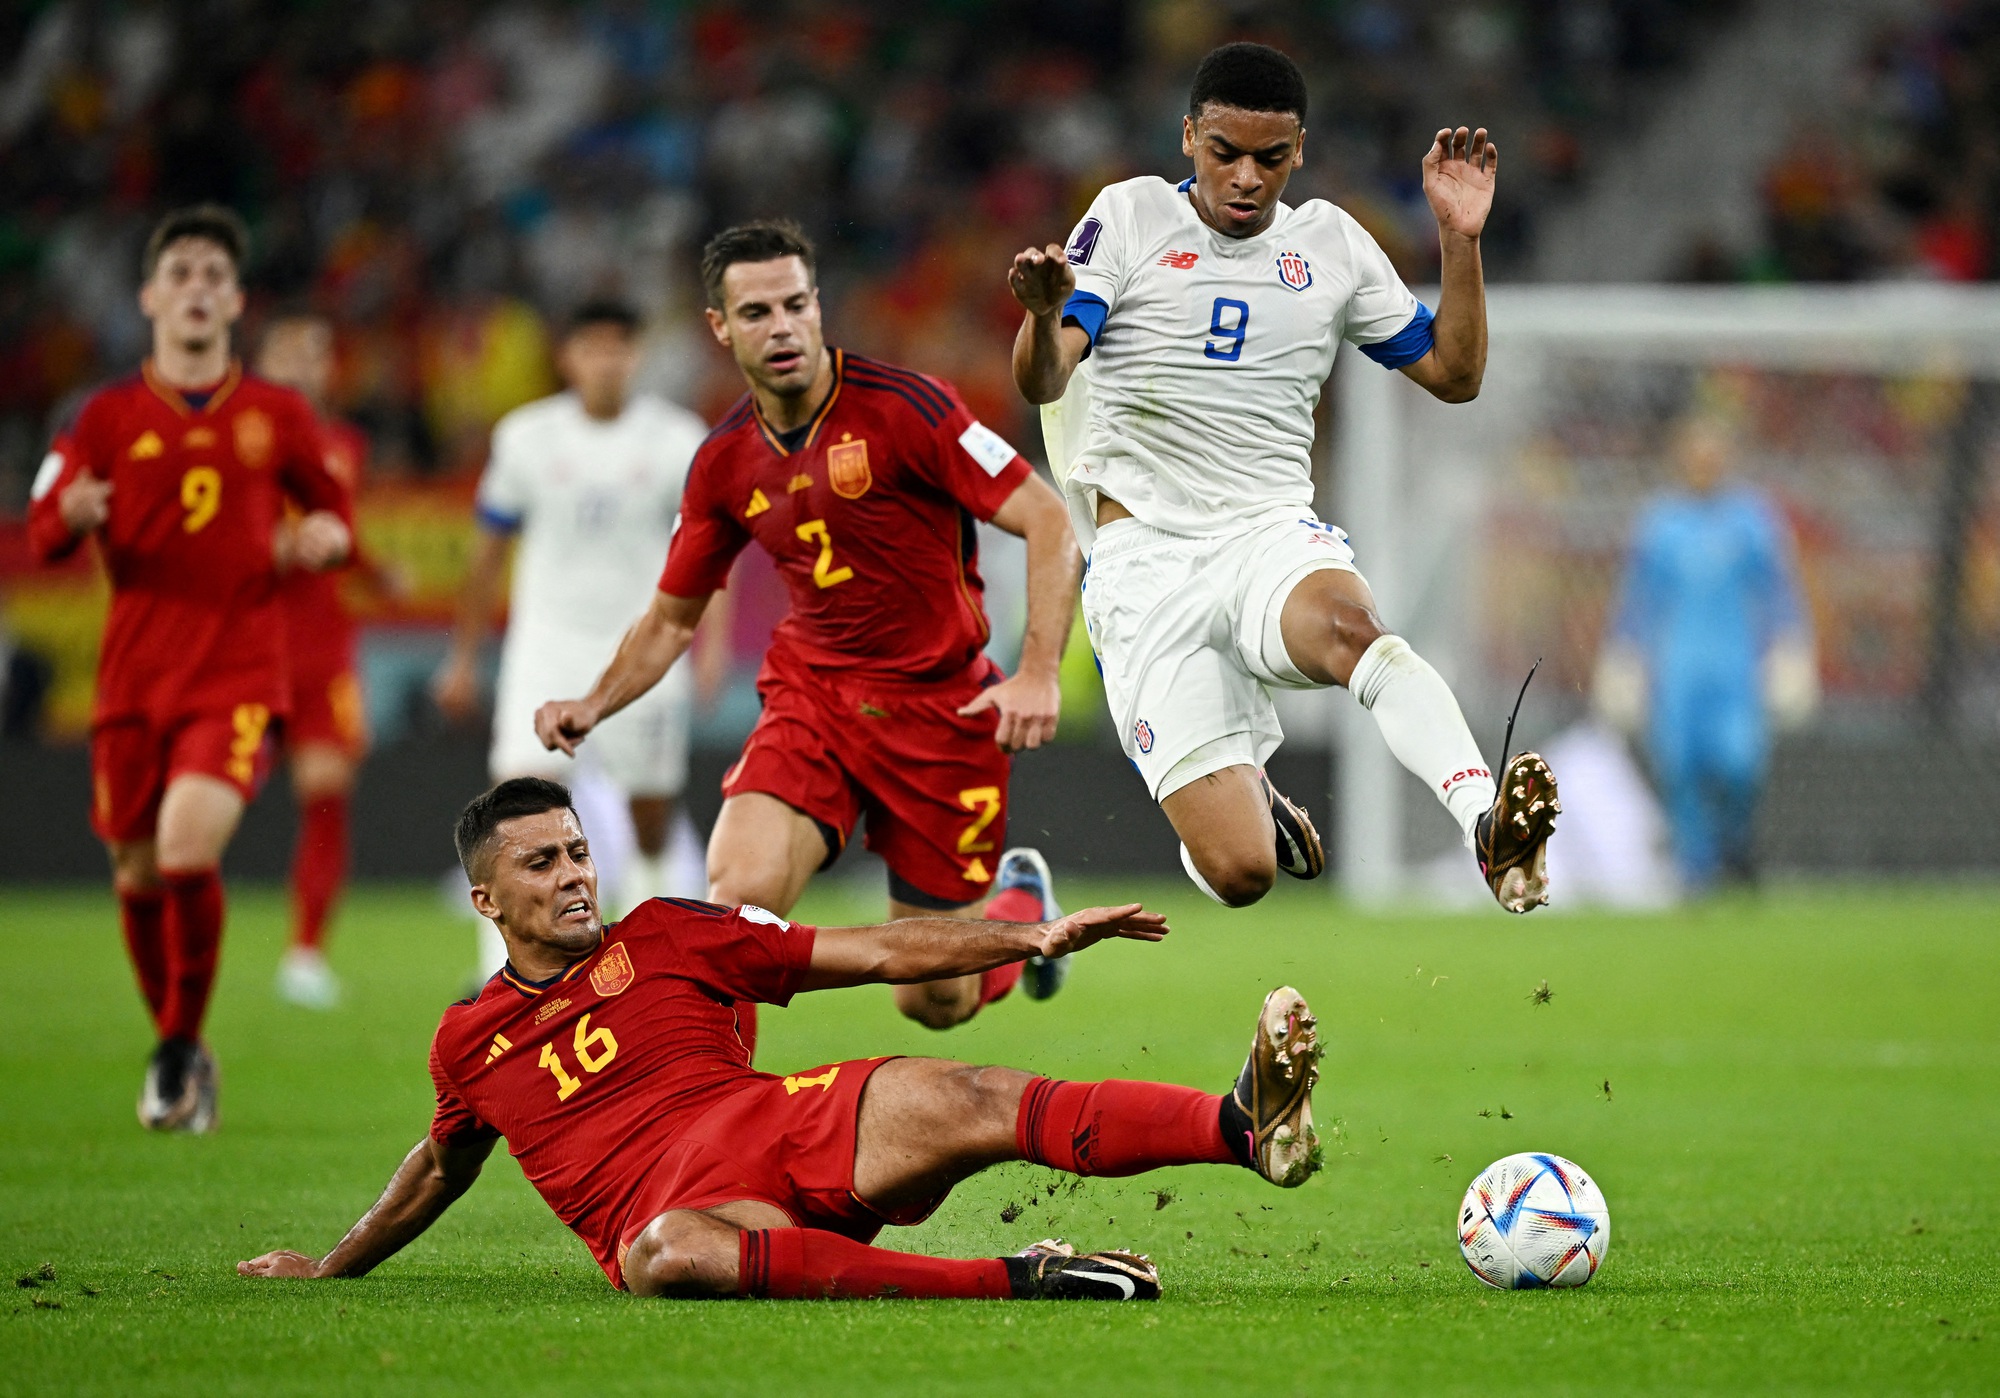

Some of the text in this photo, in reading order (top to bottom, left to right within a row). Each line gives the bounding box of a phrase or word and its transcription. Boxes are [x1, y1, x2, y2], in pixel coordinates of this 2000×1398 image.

[1283, 259, 1306, 285] CR
[1204, 297, 1249, 362] 9
[181, 465, 222, 534] 9
[795, 518, 854, 589] 2
[957, 785, 1001, 854] 2
[538, 1012, 619, 1102] 16
[782, 1062, 842, 1095] 1
